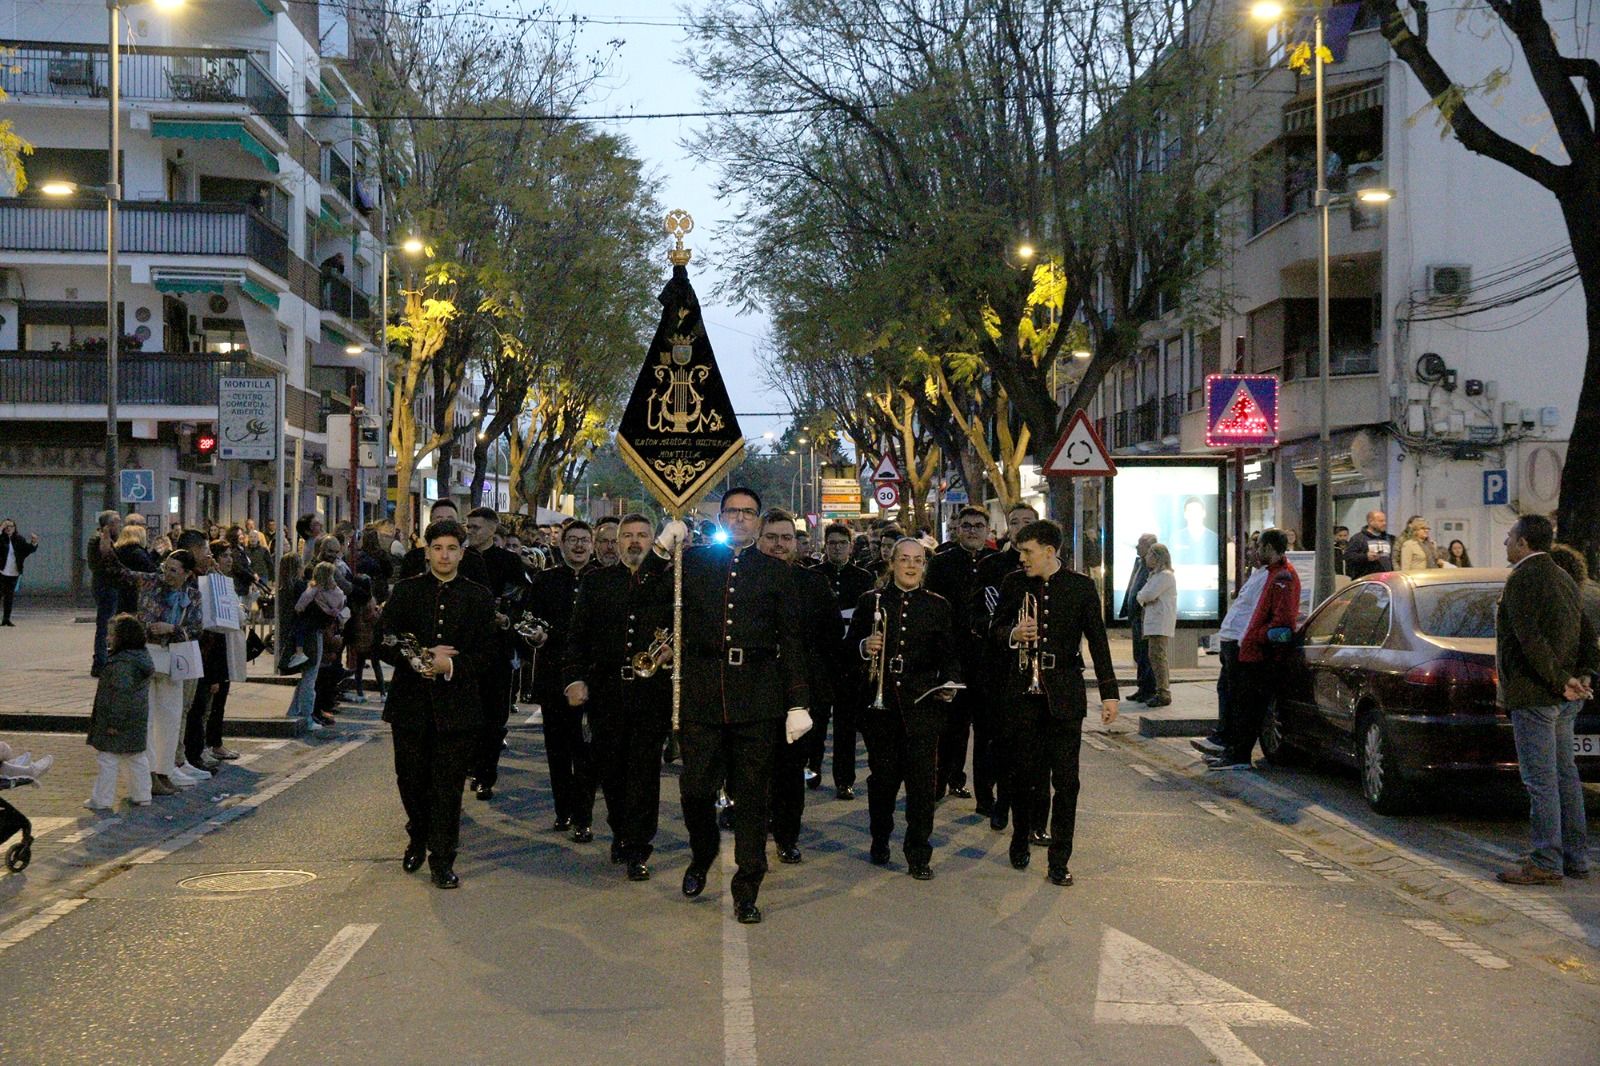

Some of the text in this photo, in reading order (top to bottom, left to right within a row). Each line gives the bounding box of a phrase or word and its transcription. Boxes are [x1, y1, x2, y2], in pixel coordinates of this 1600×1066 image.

[224, 380, 271, 389] MONTILLA
[226, 400, 269, 408] COMERCIAL
[658, 450, 701, 458] MONTILLA
[1487, 474, 1504, 502] P
[880, 491, 894, 500] 30
